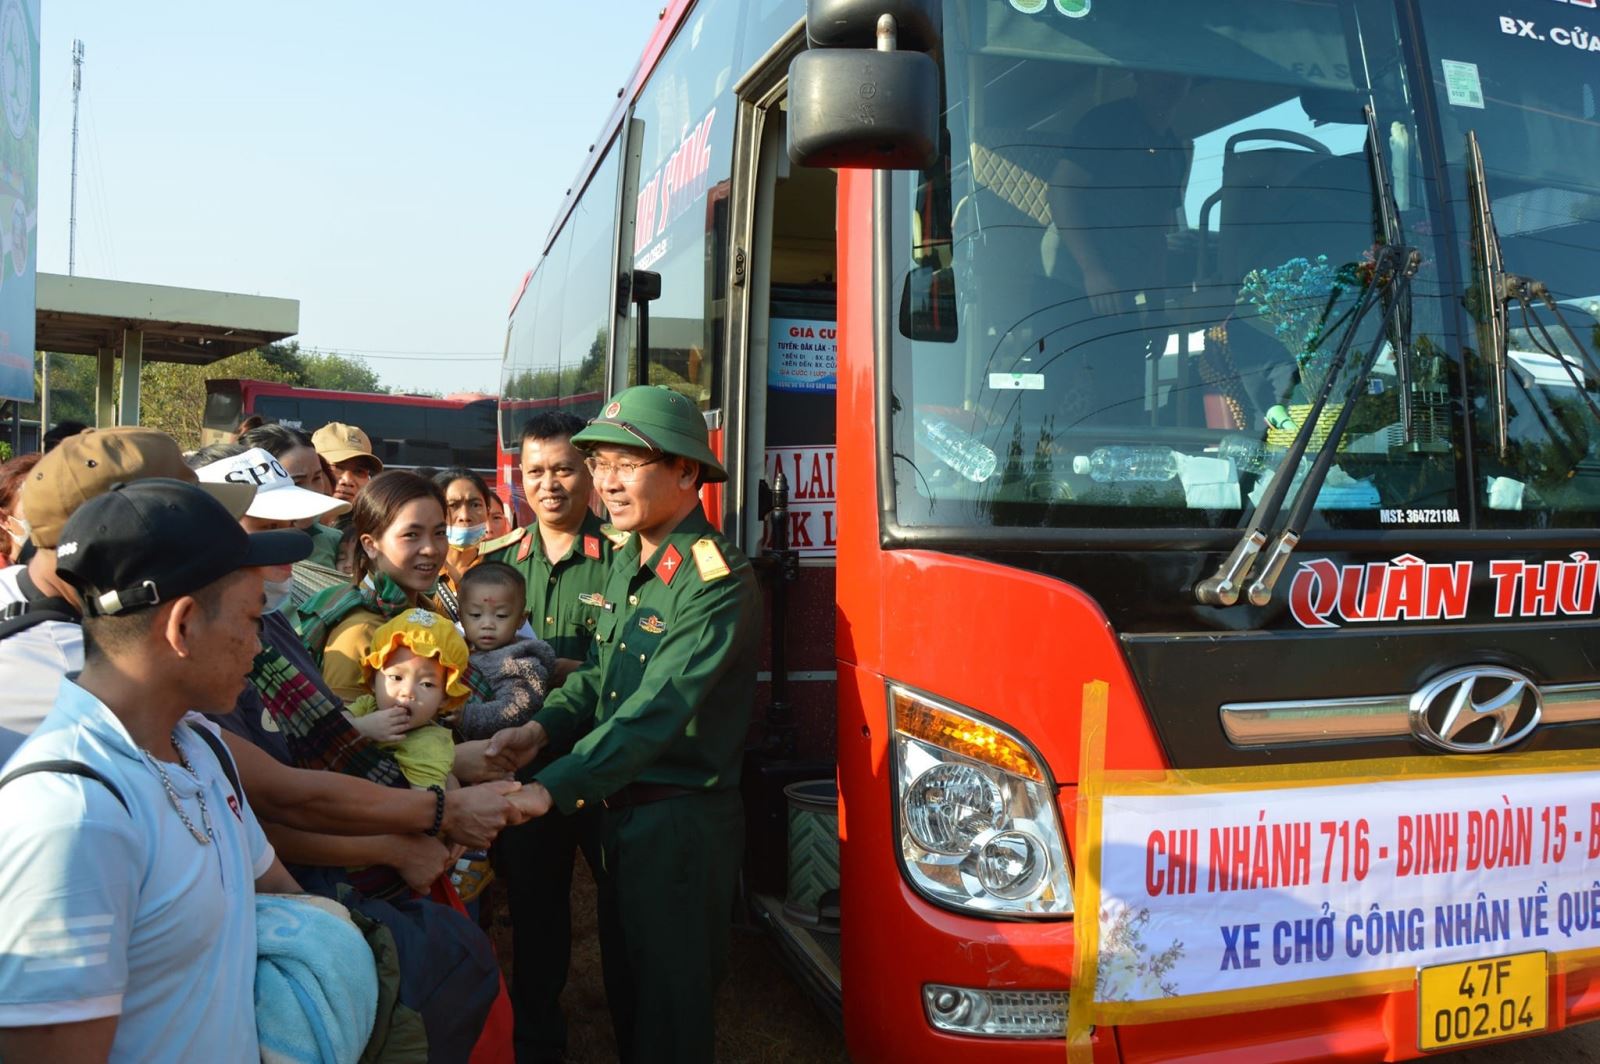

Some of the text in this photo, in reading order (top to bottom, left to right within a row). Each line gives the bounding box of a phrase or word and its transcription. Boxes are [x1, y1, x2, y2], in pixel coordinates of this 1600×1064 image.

[1499, 15, 1545, 41] BX.
[789, 325, 815, 338] GIÁ
[794, 452, 835, 499] LAI
[1380, 508, 1460, 523] MST: 36472118A
[1289, 551, 1600, 629] QUÂN THỦ
[1146, 828, 1198, 897] CHI
[1208, 810, 1311, 893] NHÁNH
[1320, 818, 1370, 884] 716
[1396, 812, 1459, 878] BINH
[1466, 795, 1533, 871] ĐOÀN
[1541, 805, 1567, 864] 15
[1220, 923, 1261, 971] XE
[1273, 901, 1336, 966] CHỞ
[1346, 903, 1425, 958] CÔNG
[1435, 892, 1511, 949] NHÂN
[1519, 880, 1549, 938] VỀ
[1434, 960, 1534, 1043] 47F 002.04
